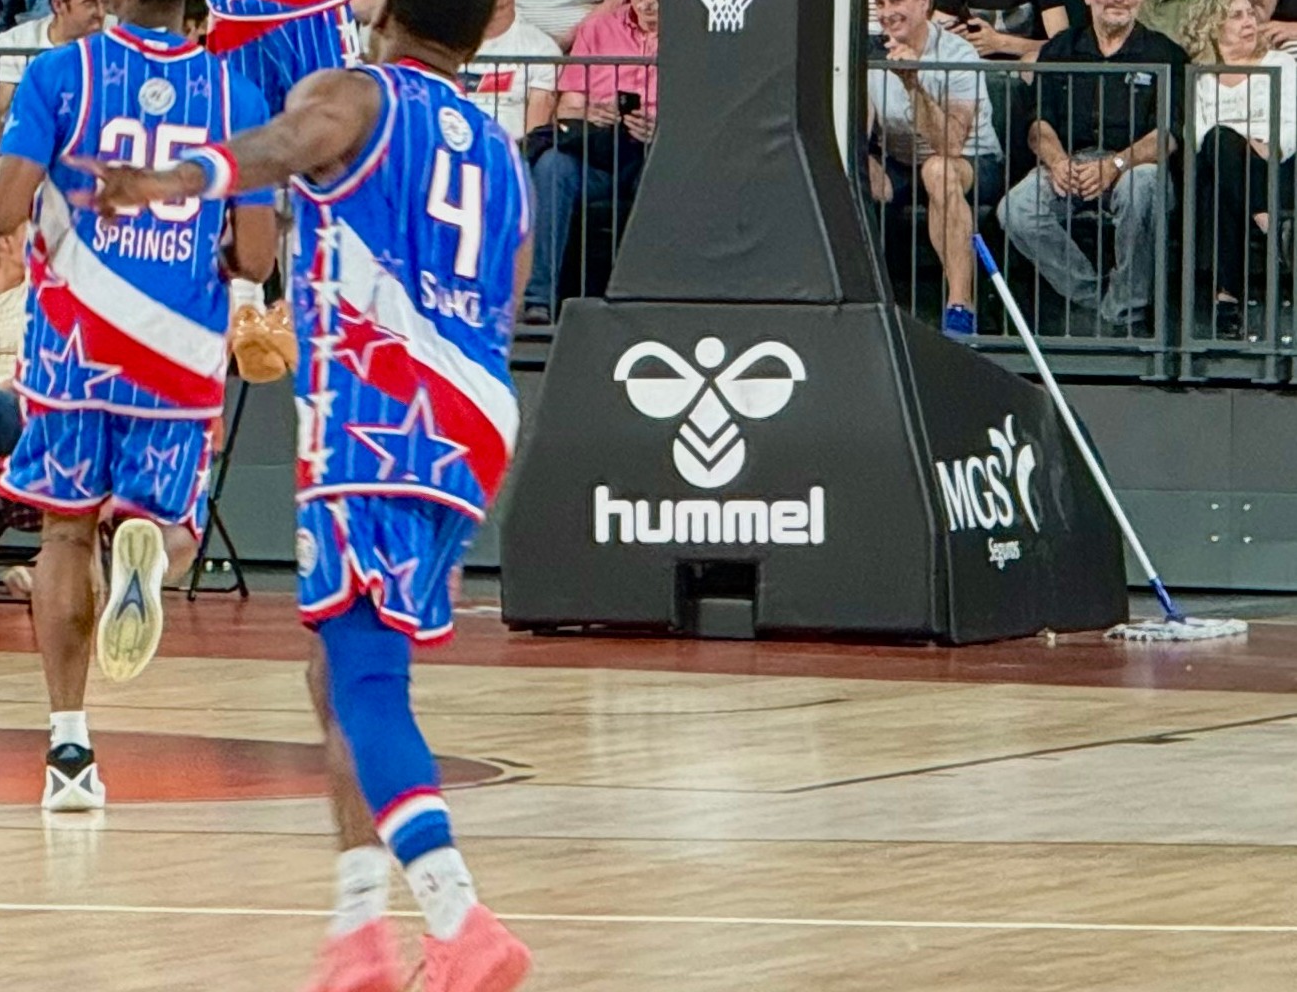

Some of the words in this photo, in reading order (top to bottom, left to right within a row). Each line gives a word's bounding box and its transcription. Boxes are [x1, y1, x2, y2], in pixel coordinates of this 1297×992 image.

[92, 217, 195, 264] SPRINGS
[426, 147, 483, 280] 4
[595, 489, 825, 544] hummel
[935, 455, 1014, 531] MGS
